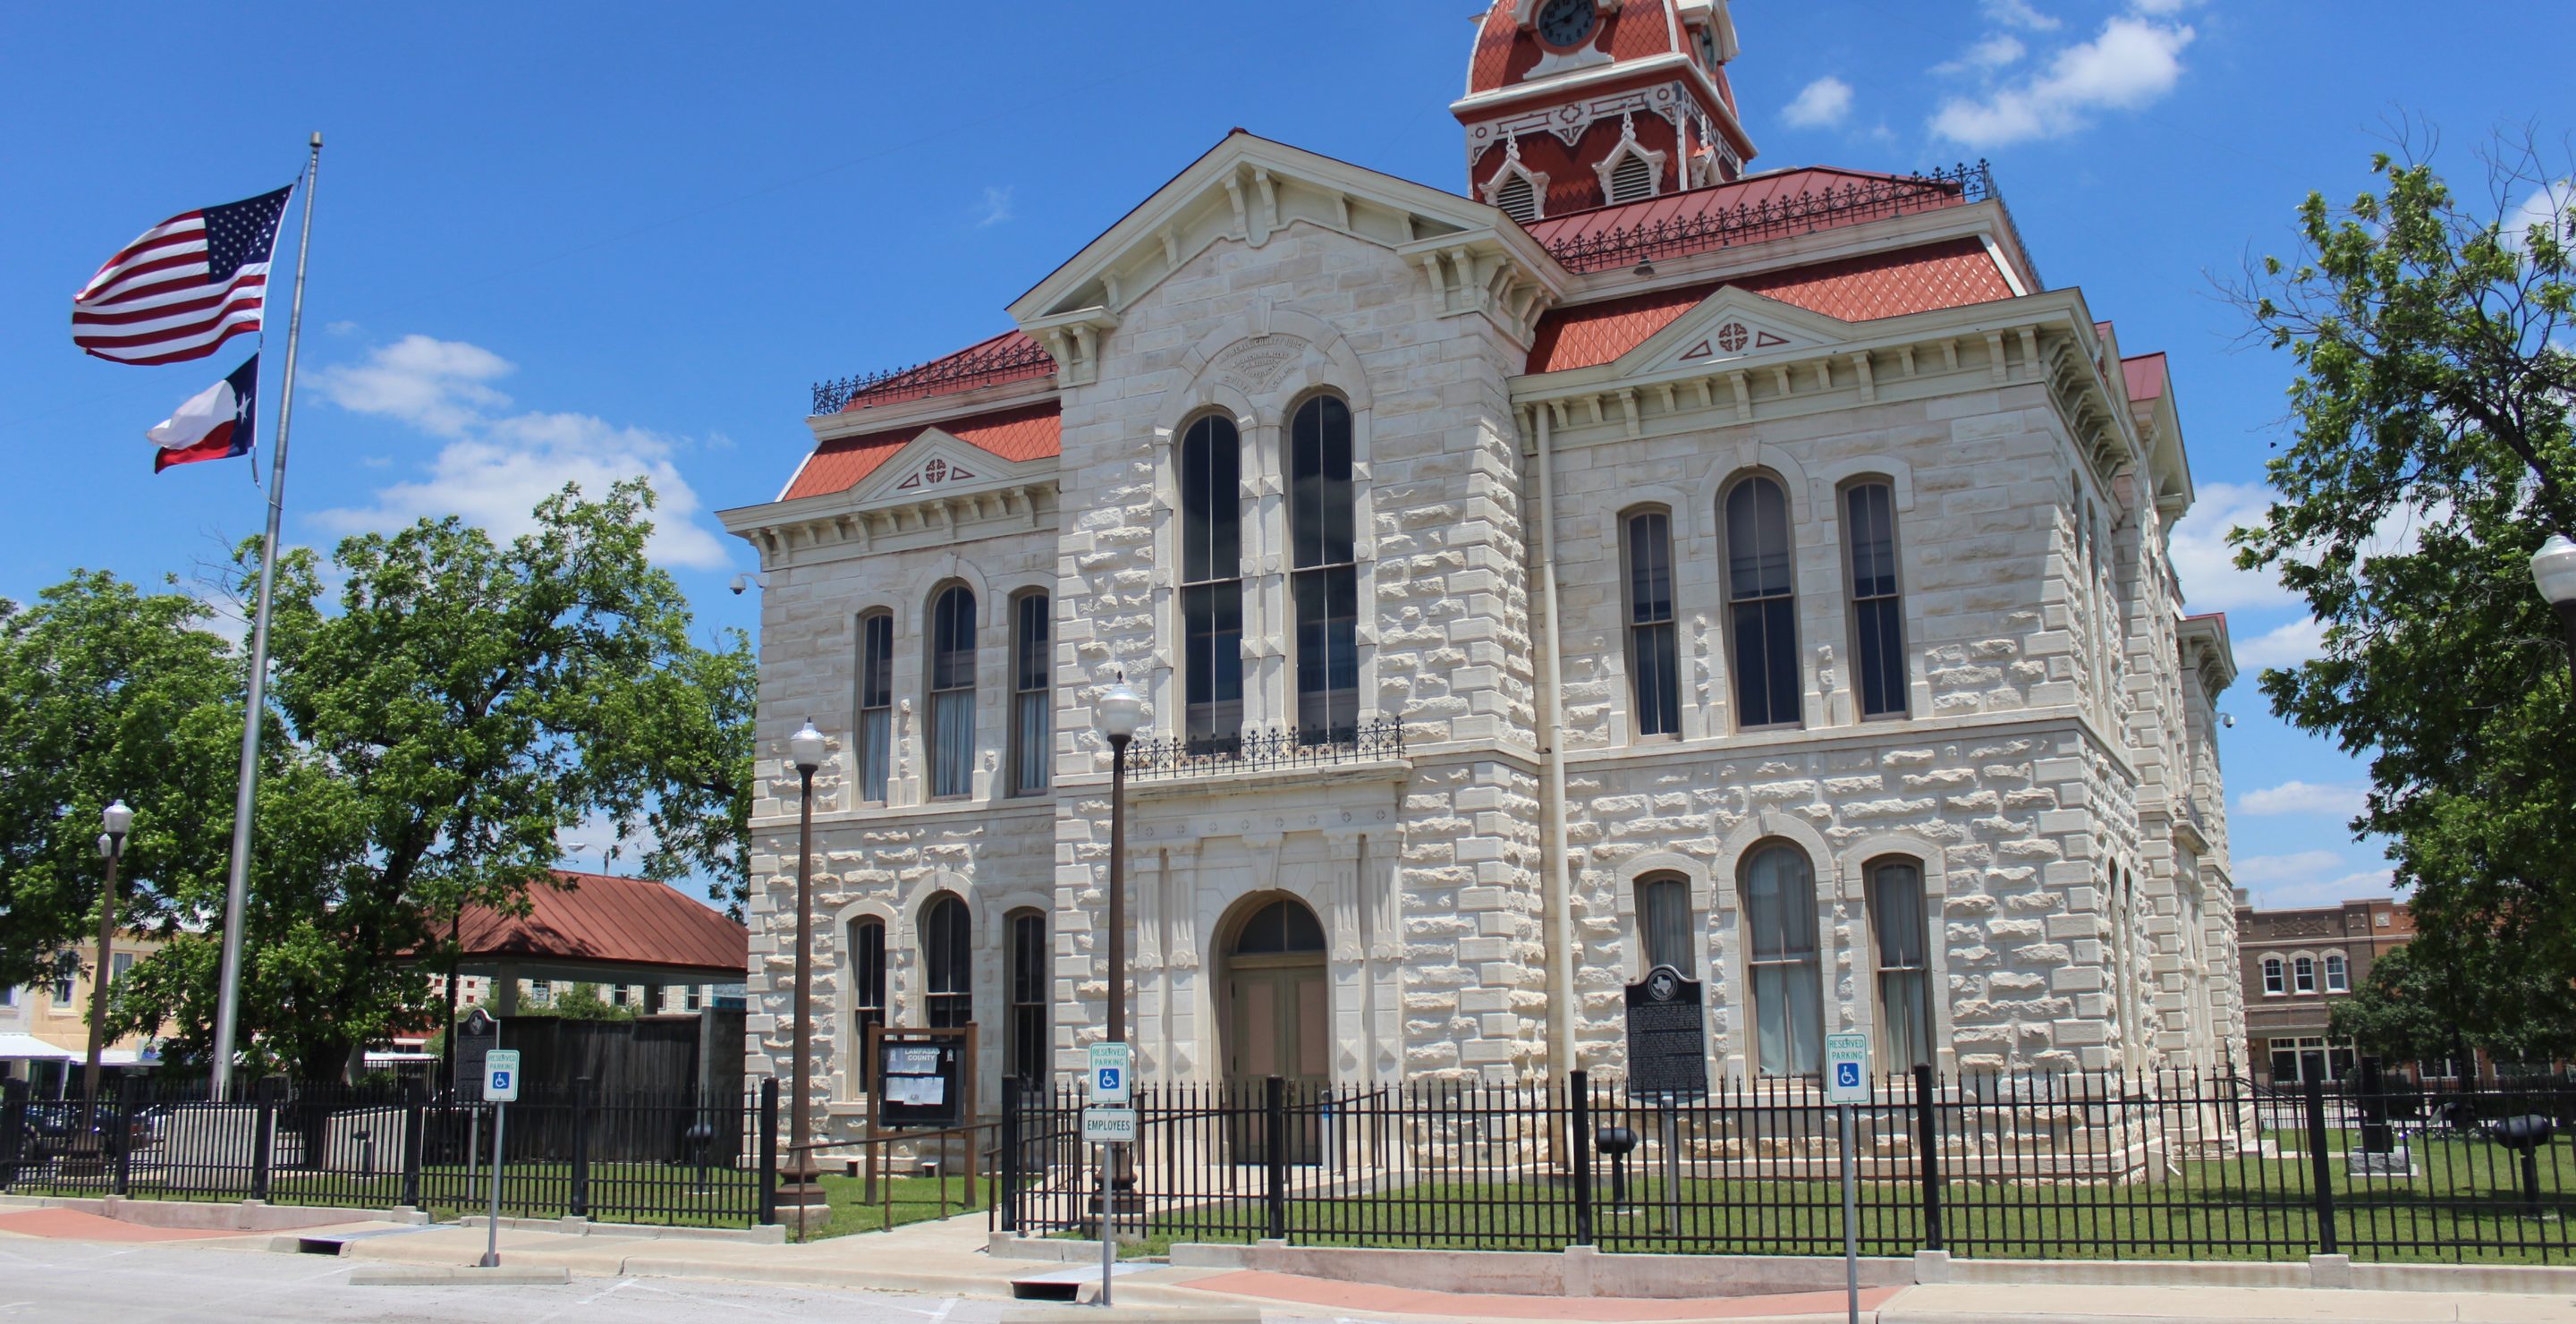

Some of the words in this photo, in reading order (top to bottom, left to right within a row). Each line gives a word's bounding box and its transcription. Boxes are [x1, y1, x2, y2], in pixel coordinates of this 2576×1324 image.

[1829, 1039, 1864, 1048] RESERVED
[1093, 1048, 1126, 1057] RESERVED
[1832, 1051, 1862, 1060] PARKING
[1095, 1058, 1123, 1066] PARKING
[1087, 1120, 1131, 1131] EMPLOYEES
